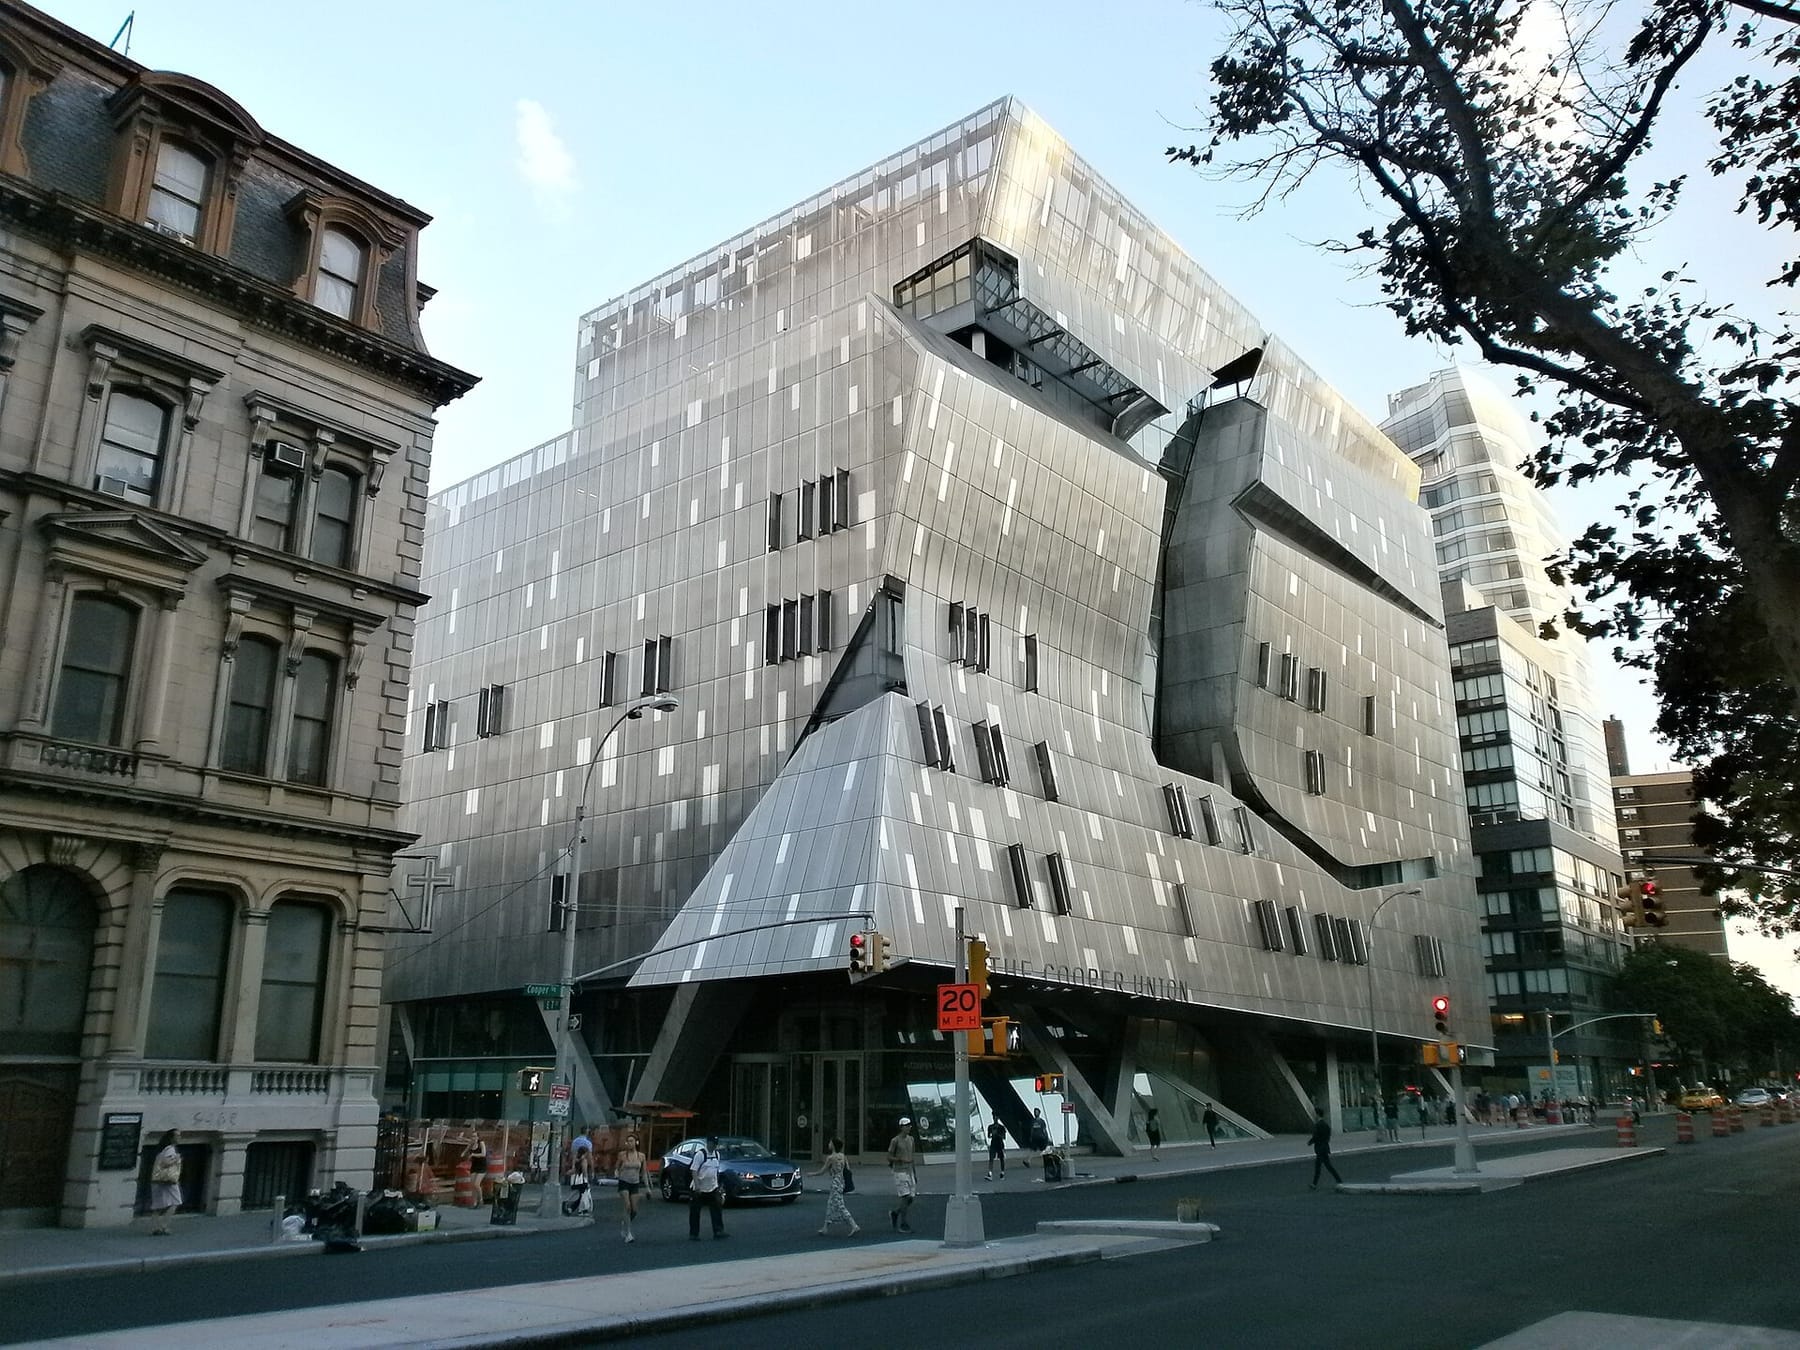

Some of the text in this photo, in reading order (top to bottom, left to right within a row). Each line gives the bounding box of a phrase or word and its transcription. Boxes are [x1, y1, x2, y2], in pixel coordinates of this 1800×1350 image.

[527, 984, 550, 996] Cooper
[989, 957, 1189, 1003] THE COOPER UNION
[942, 989, 976, 1012] 20
